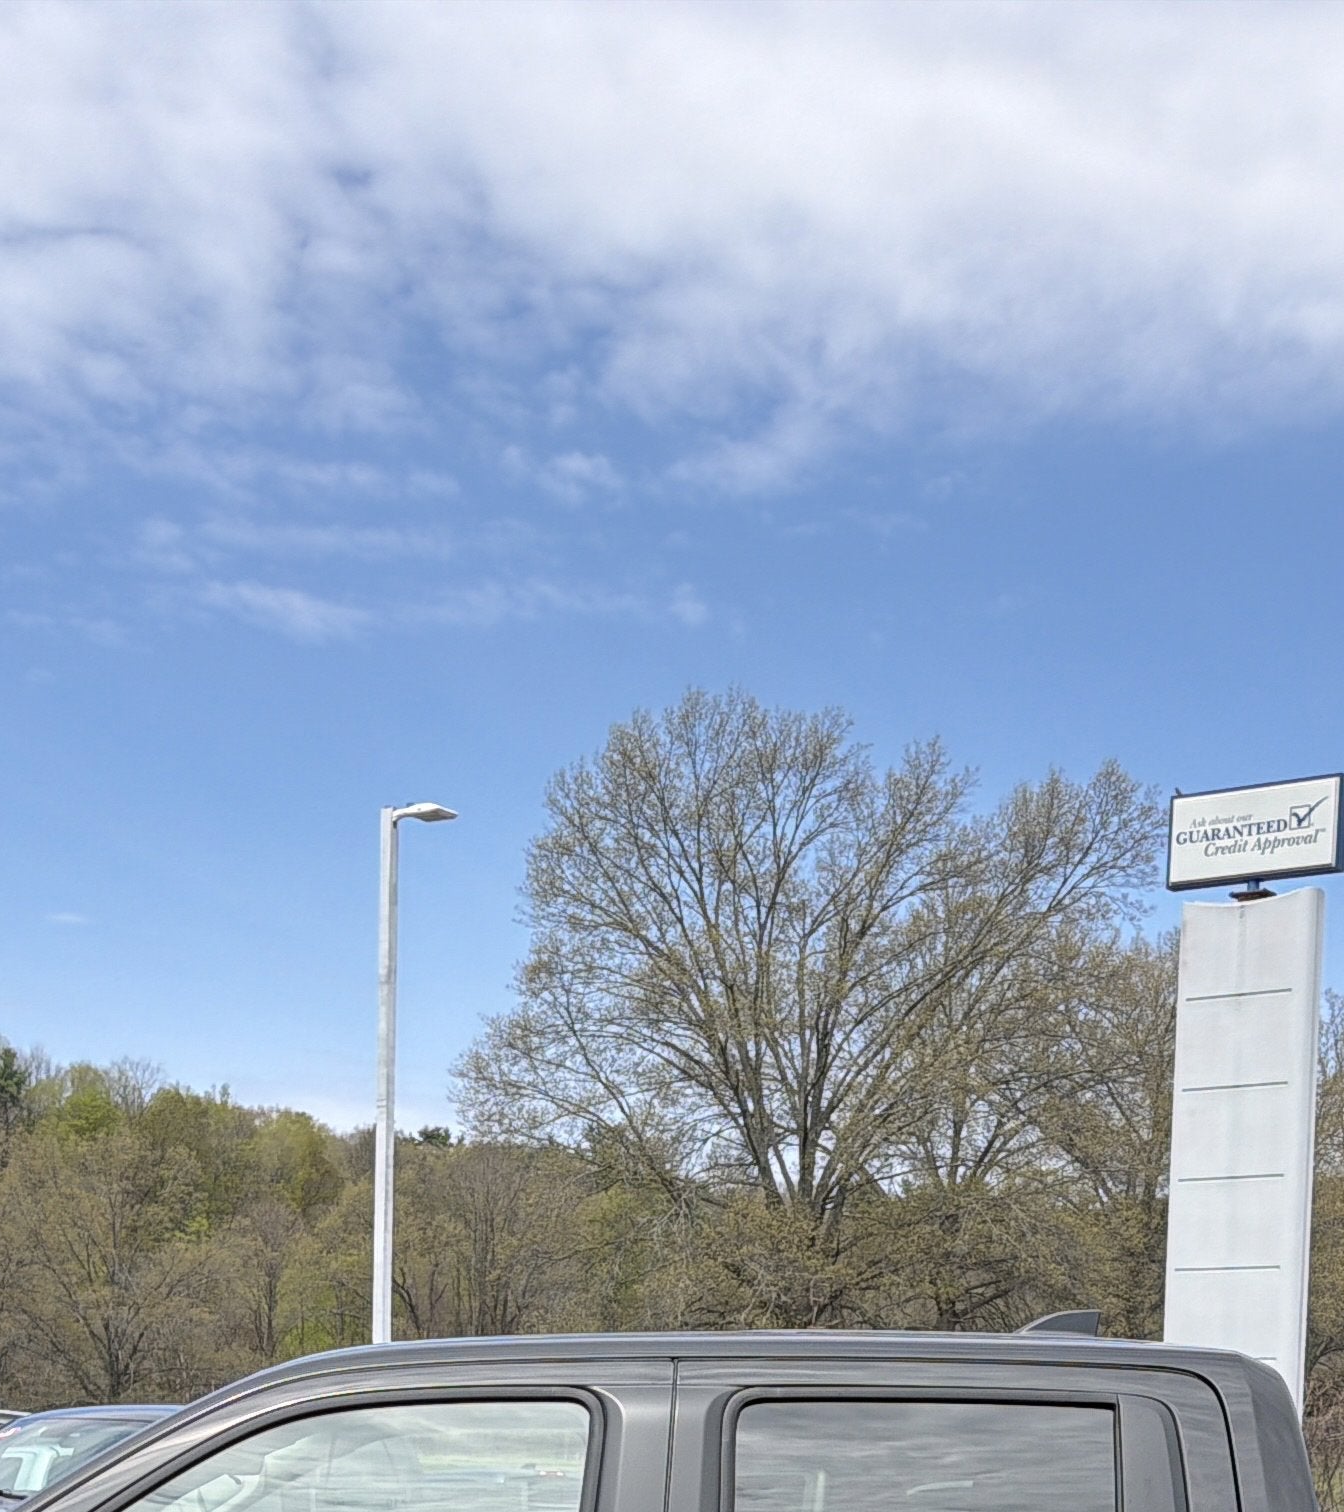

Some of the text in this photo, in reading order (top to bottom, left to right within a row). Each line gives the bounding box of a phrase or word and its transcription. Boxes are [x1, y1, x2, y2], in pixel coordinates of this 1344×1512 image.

[1190, 814, 1253, 829] Ask about our
[1176, 818, 1288, 846] GUARANTEED
[1204, 839, 1247, 858] Credit
